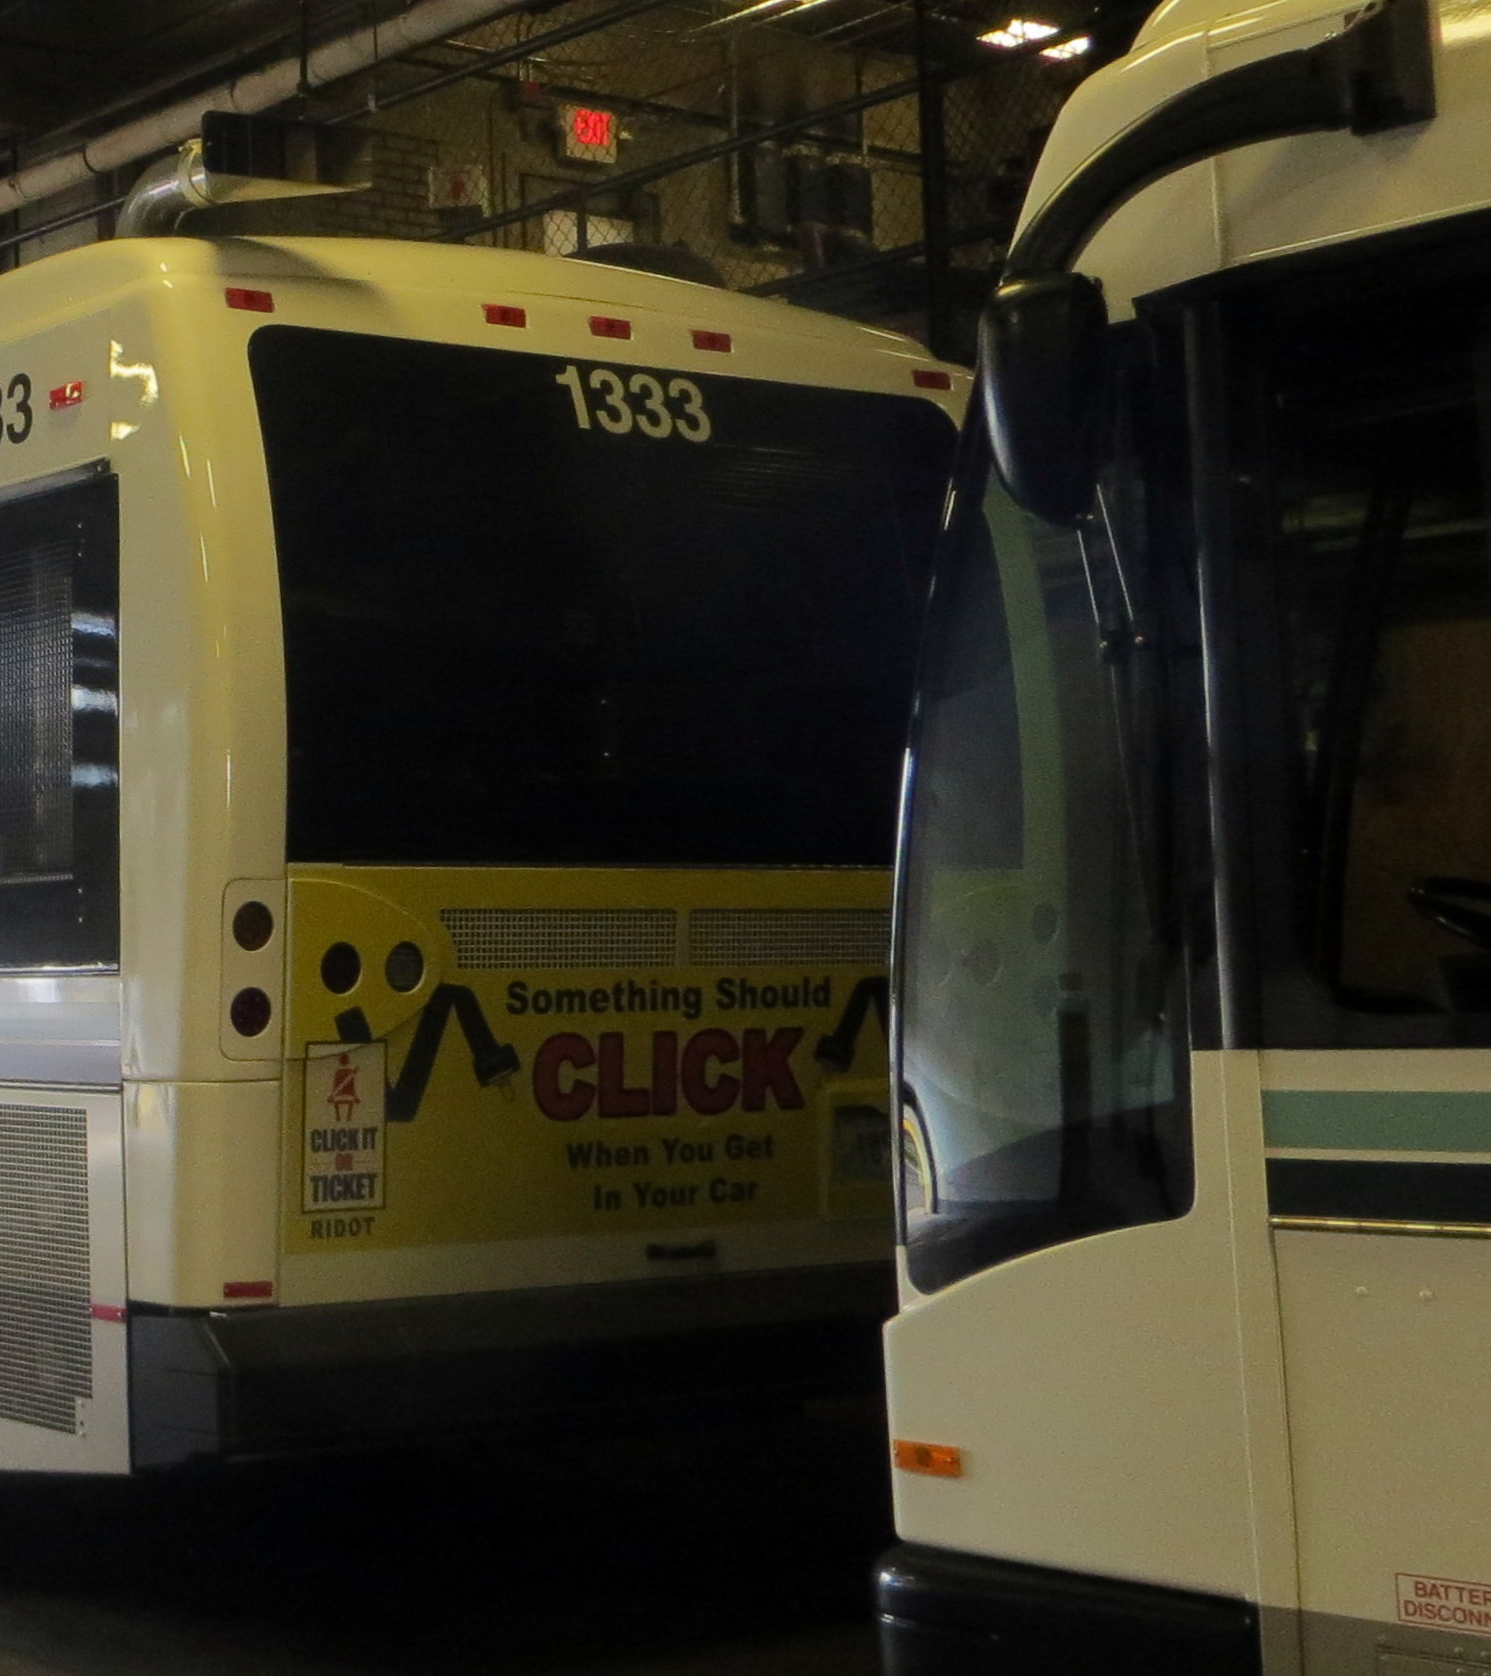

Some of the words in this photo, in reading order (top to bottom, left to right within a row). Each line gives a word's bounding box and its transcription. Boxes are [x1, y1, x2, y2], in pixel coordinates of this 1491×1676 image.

[574, 109, 610, 146] EXIT
[555, 365, 711, 442] 1333
[506, 979, 702, 1020] Something
[716, 977, 831, 1010] Should
[533, 1026, 805, 1122] CLICK
[310, 1128, 359, 1152] CLICK
[361, 1127, 378, 1150] IT
[566, 1141, 649, 1169] When
[662, 1137, 713, 1164] You
[725, 1133, 773, 1160] Get
[310, 1172, 377, 1202] TICKET
[594, 1184, 621, 1209] In
[633, 1181, 699, 1208] Your
[710, 1177, 758, 1203] Car
[311, 1216, 375, 1239] RIDOT
